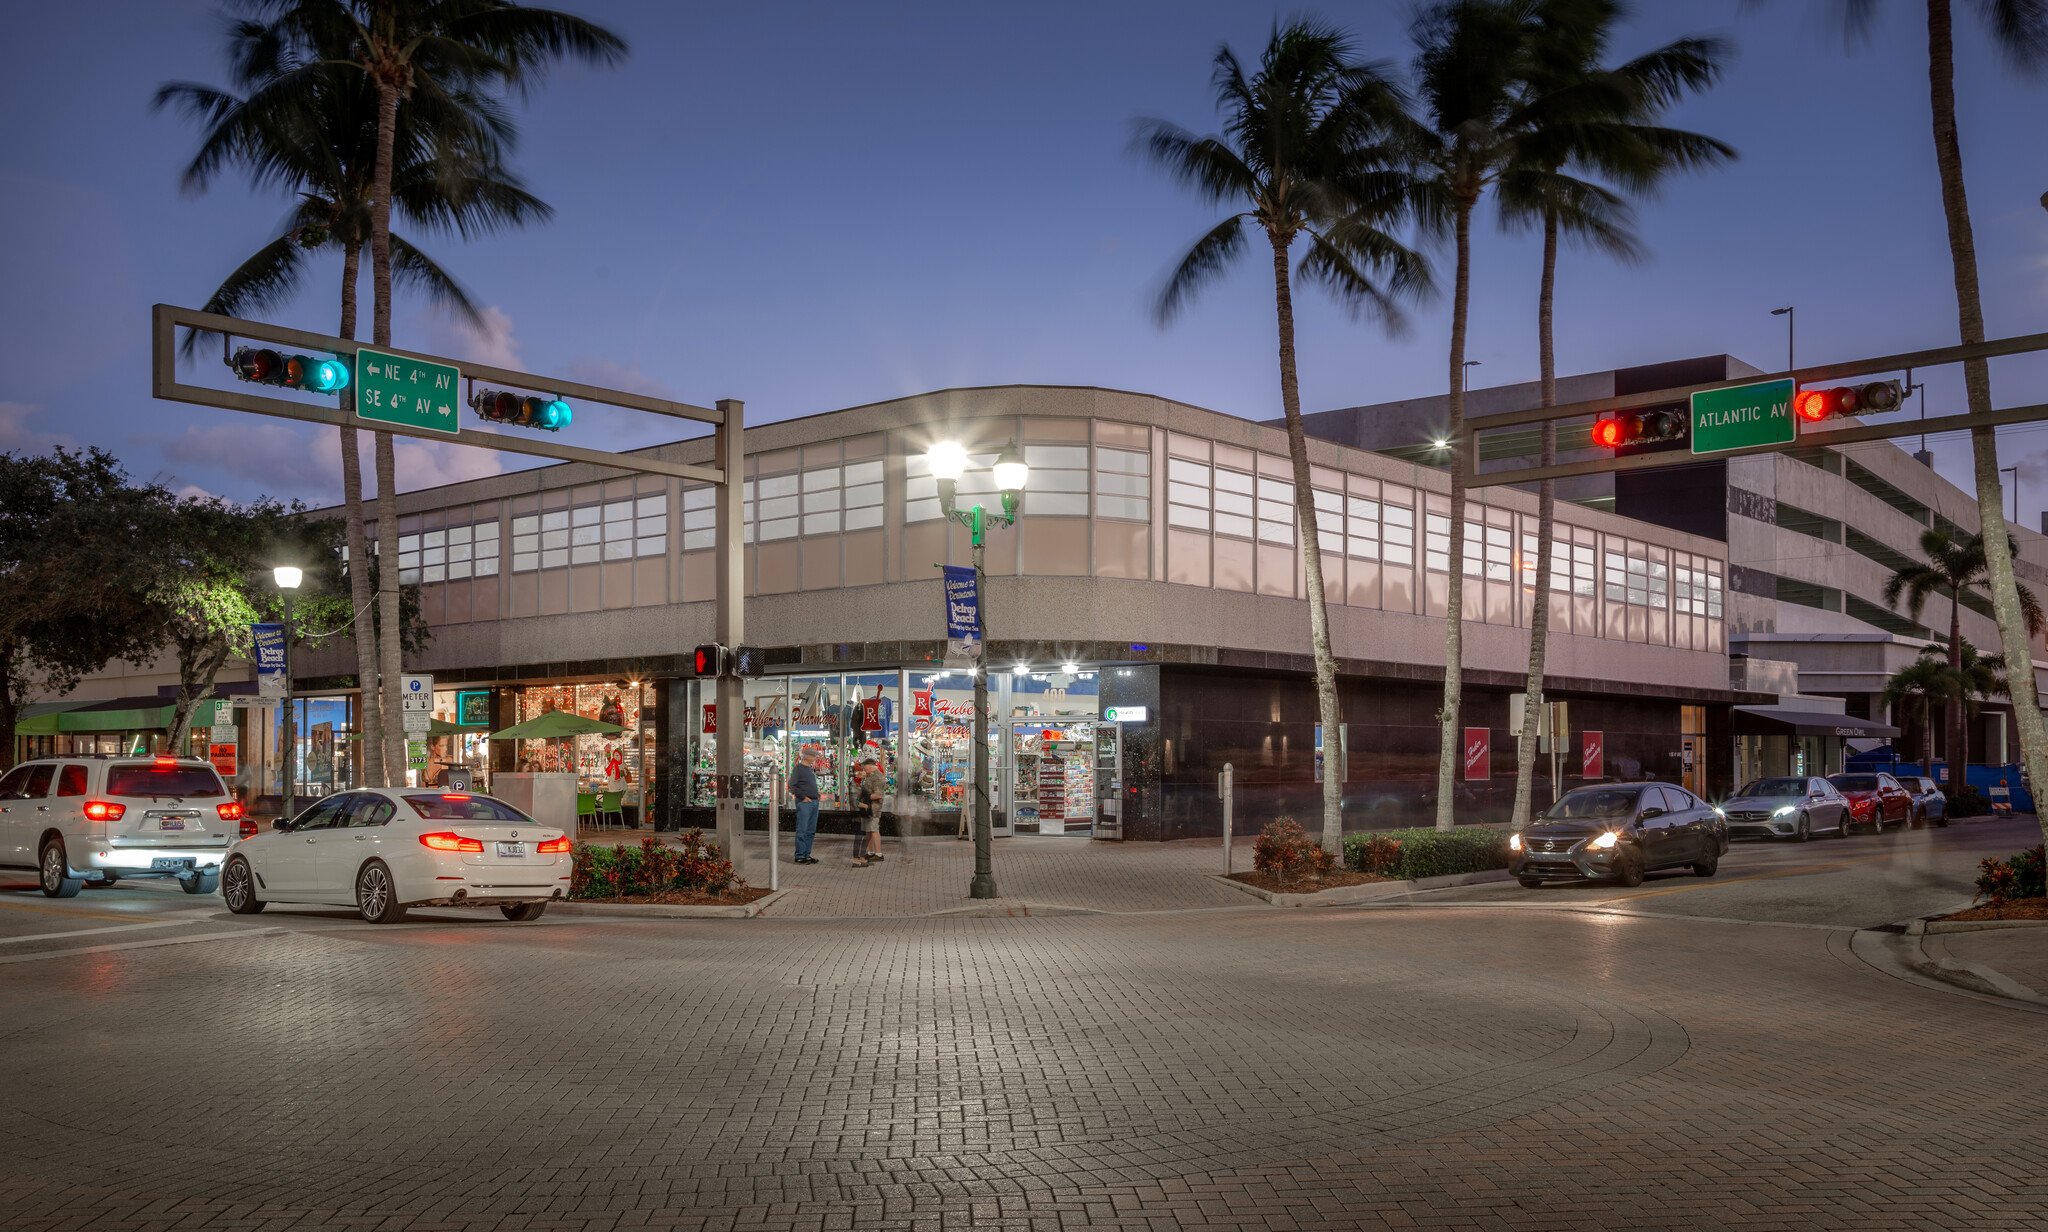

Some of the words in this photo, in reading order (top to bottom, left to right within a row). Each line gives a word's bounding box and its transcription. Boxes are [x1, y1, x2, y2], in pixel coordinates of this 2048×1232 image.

[385, 364, 400, 381] NE
[410, 369, 426, 384] 4TH
[435, 374, 451, 390] AV
[366, 389, 381, 407] SE
[390, 393, 407, 408] 4TH
[416, 398, 431, 414] AV
[1699, 406, 1761, 428] ATLANTIC
[1770, 402, 1788, 418] AV
[946, 580, 968, 590] Welcome
[950, 602, 977, 615] Delray
[952, 612, 975, 624] Beach
[260, 647, 285, 656] Delray
[261, 655, 283, 663] Beach
[402, 693, 429, 701] METER
[1043, 688, 1066, 702] 400
[744, 708, 782, 728] Huber's
[792, 708, 838, 730] Pharmacy
[410, 757, 427, 765] 3173
[580, 757, 599, 768] 2019
[1467, 744, 1488, 771] Pharmacy
